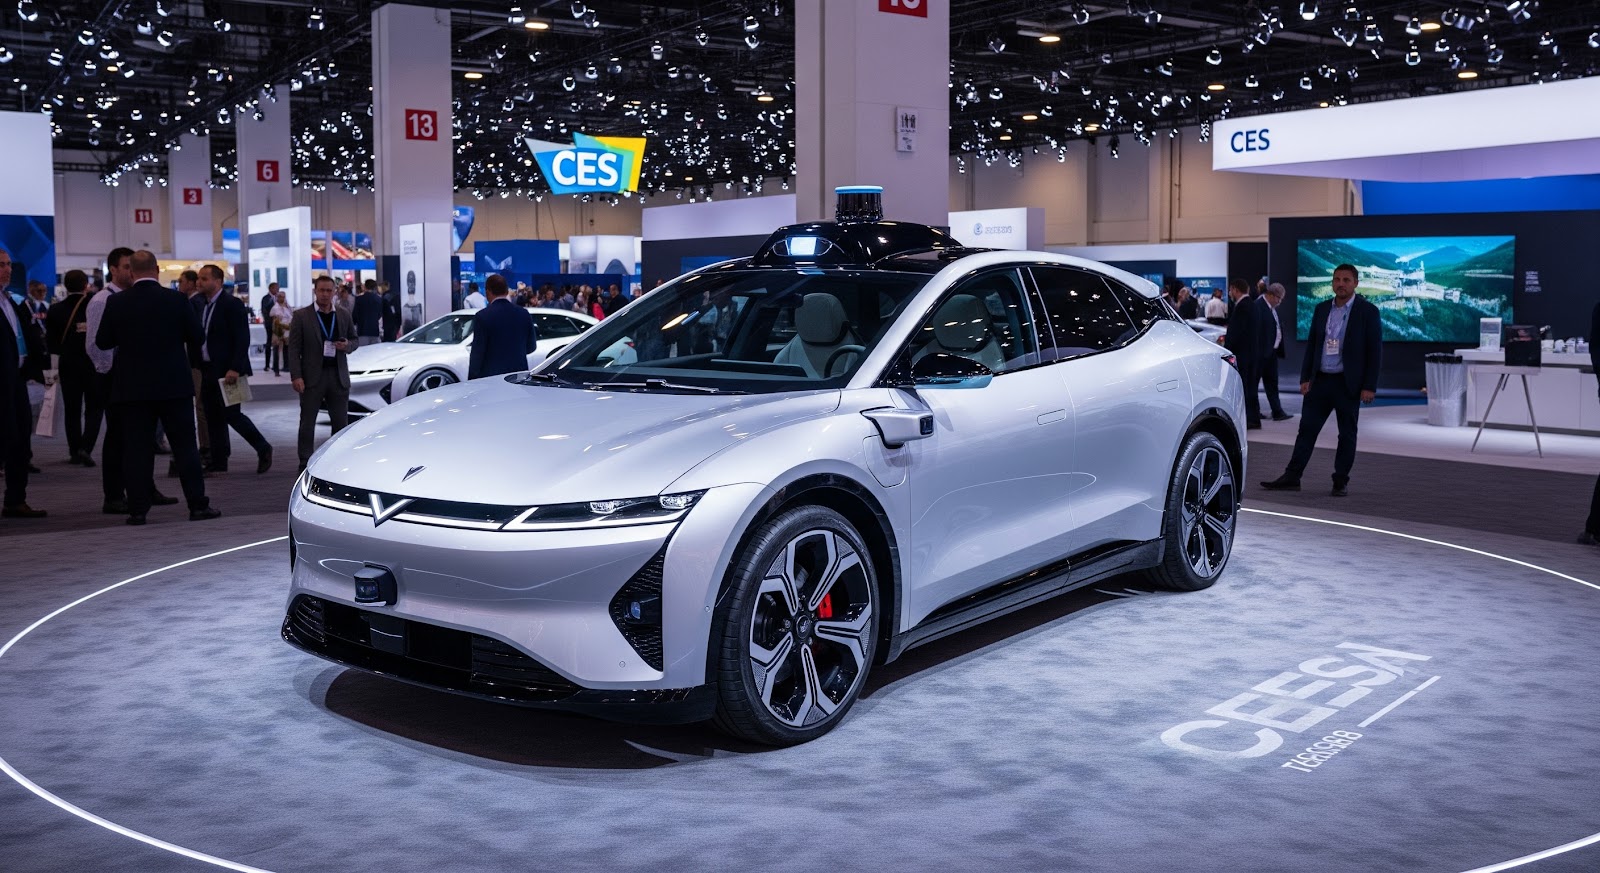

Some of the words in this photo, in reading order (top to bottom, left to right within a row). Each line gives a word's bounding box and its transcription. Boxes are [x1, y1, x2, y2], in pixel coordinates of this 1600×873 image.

[408, 113, 434, 138] 13
[1230, 128, 1271, 154] CES
[262, 163, 273, 180] 6
[551, 149, 619, 187] CES
[188, 190, 198, 203] 3
